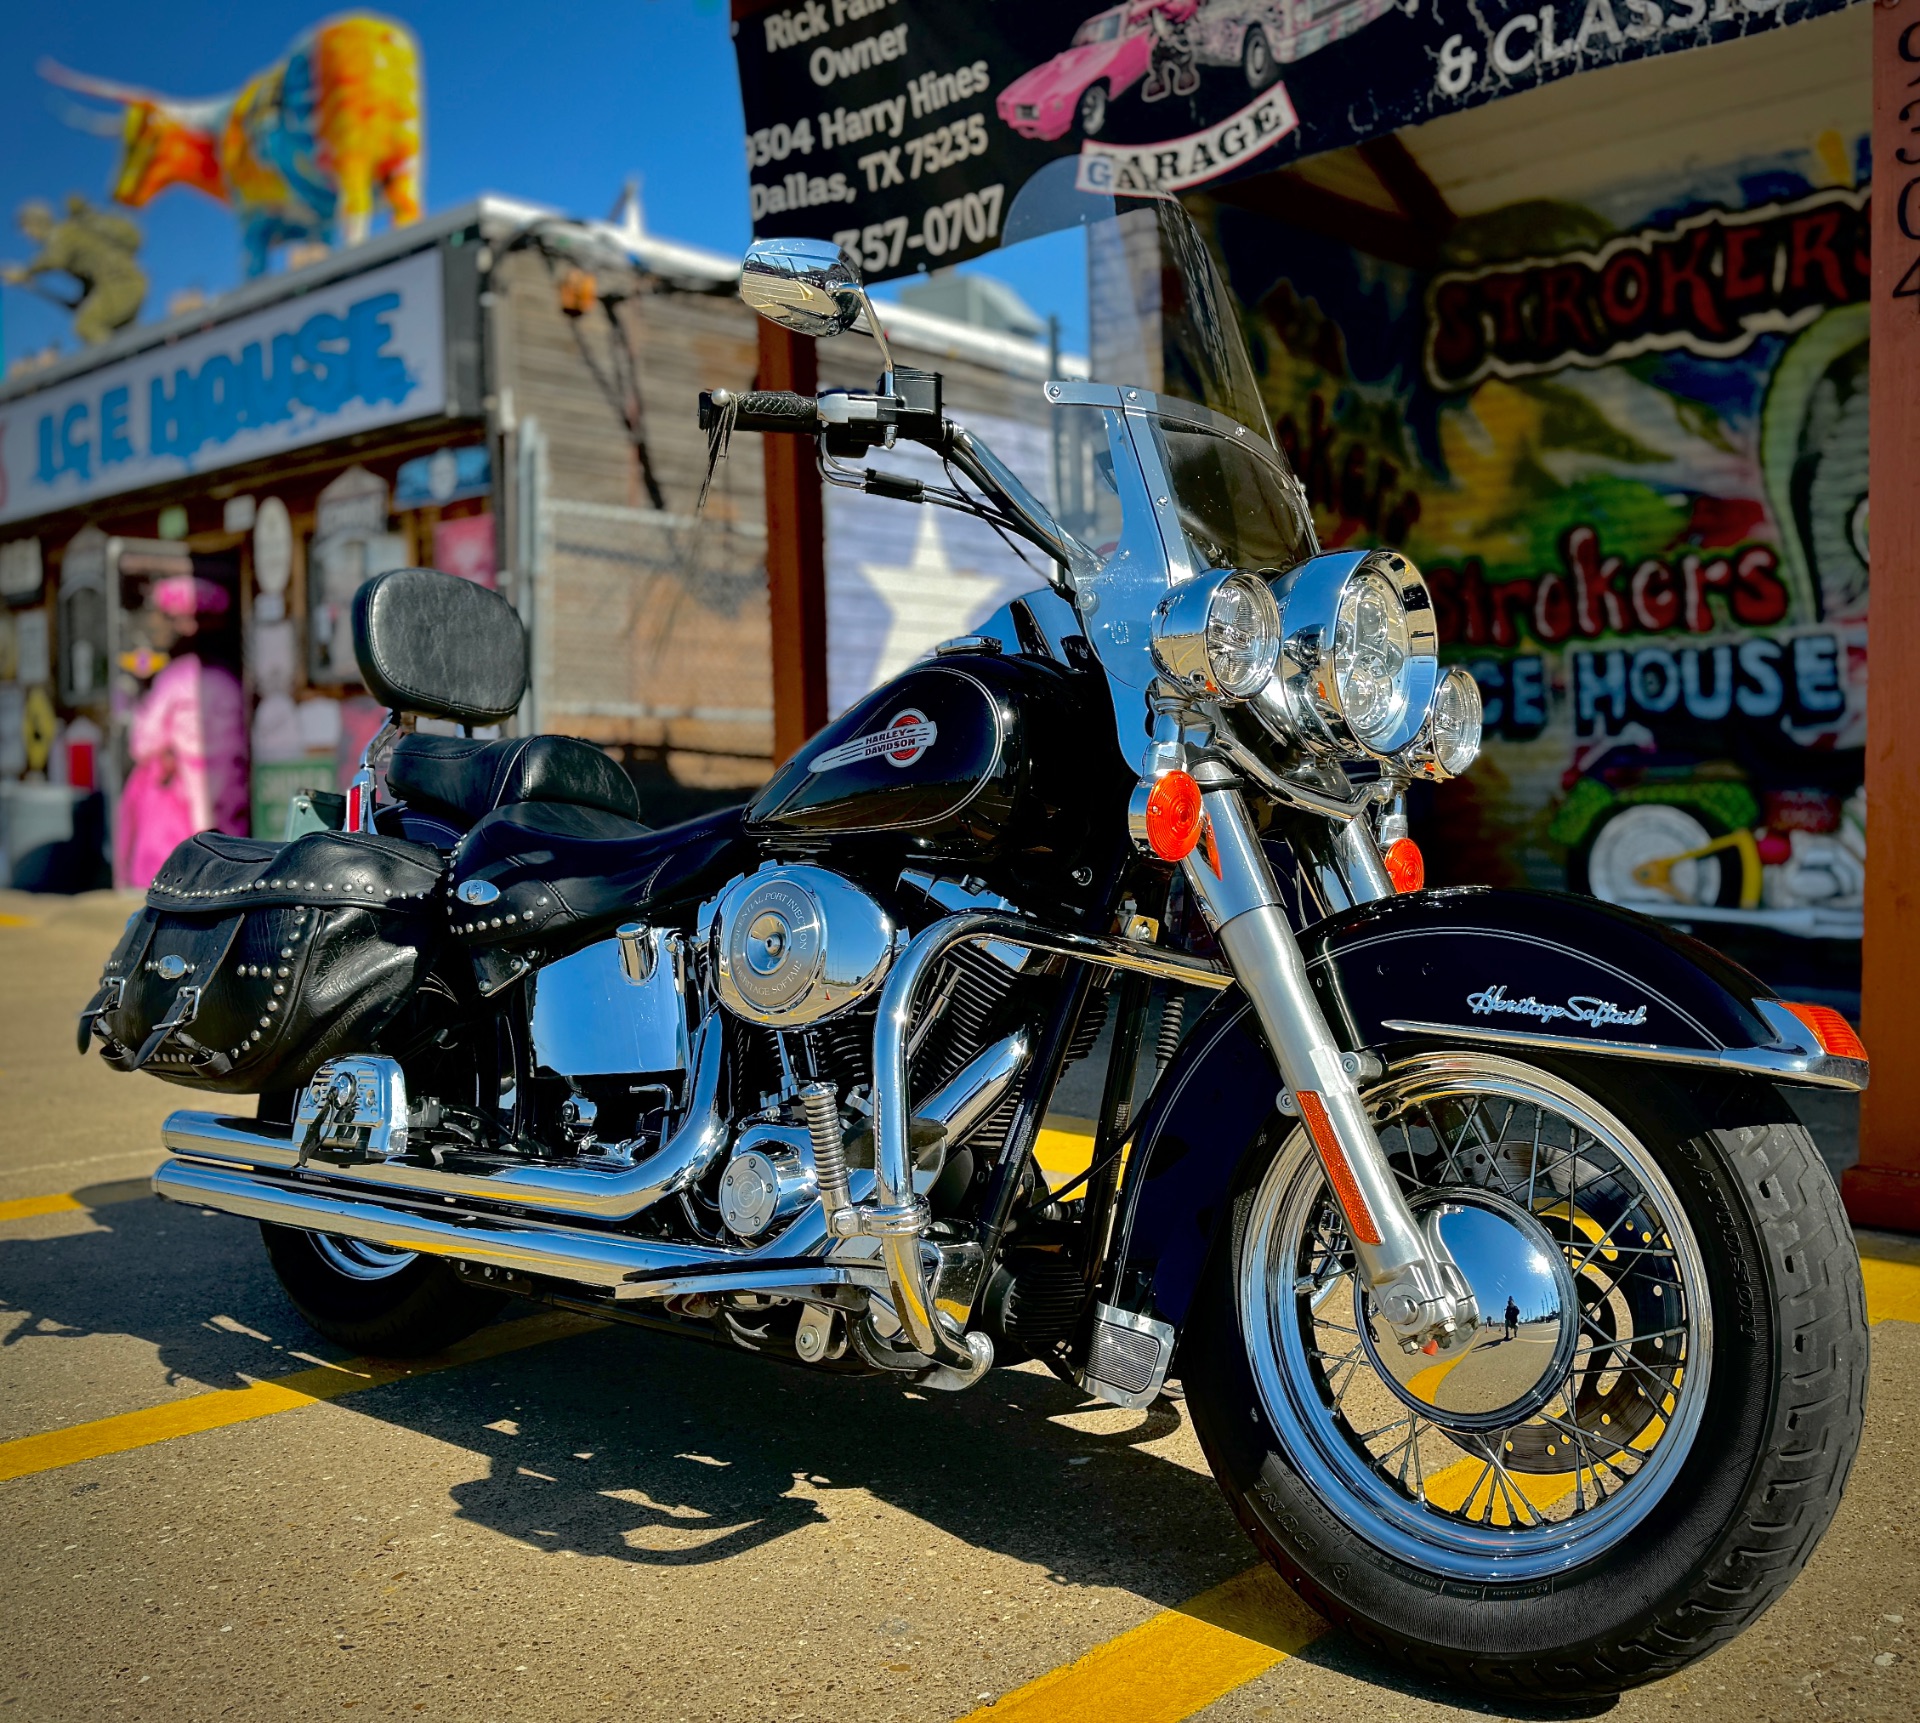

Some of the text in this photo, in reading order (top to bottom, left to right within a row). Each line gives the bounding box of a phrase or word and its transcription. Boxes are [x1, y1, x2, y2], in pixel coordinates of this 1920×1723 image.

[763, 0, 830, 53] Rick
[809, 23, 909, 86] Owner
[1437, 33, 1477, 95] &
[818, 94, 907, 150] Harry
[907, 60, 990, 119] Hines
[751, 112, 989, 222] Dallas, TX 75235
[1087, 99, 1284, 191] GARAGE
[1434, 206, 1872, 365] STROKER
[36, 292, 417, 488] ICE HOUSE
[1471, 634, 1846, 725] CE HOUSE
[864, 737, 916, 757] DAVIDSON
[865, 728, 908, 746] HARLEY
[765, 892, 787, 902] PORT
[1466, 984, 1648, 1029] Heritage Softail
[1253, 1474, 1319, 1552] DUNL
